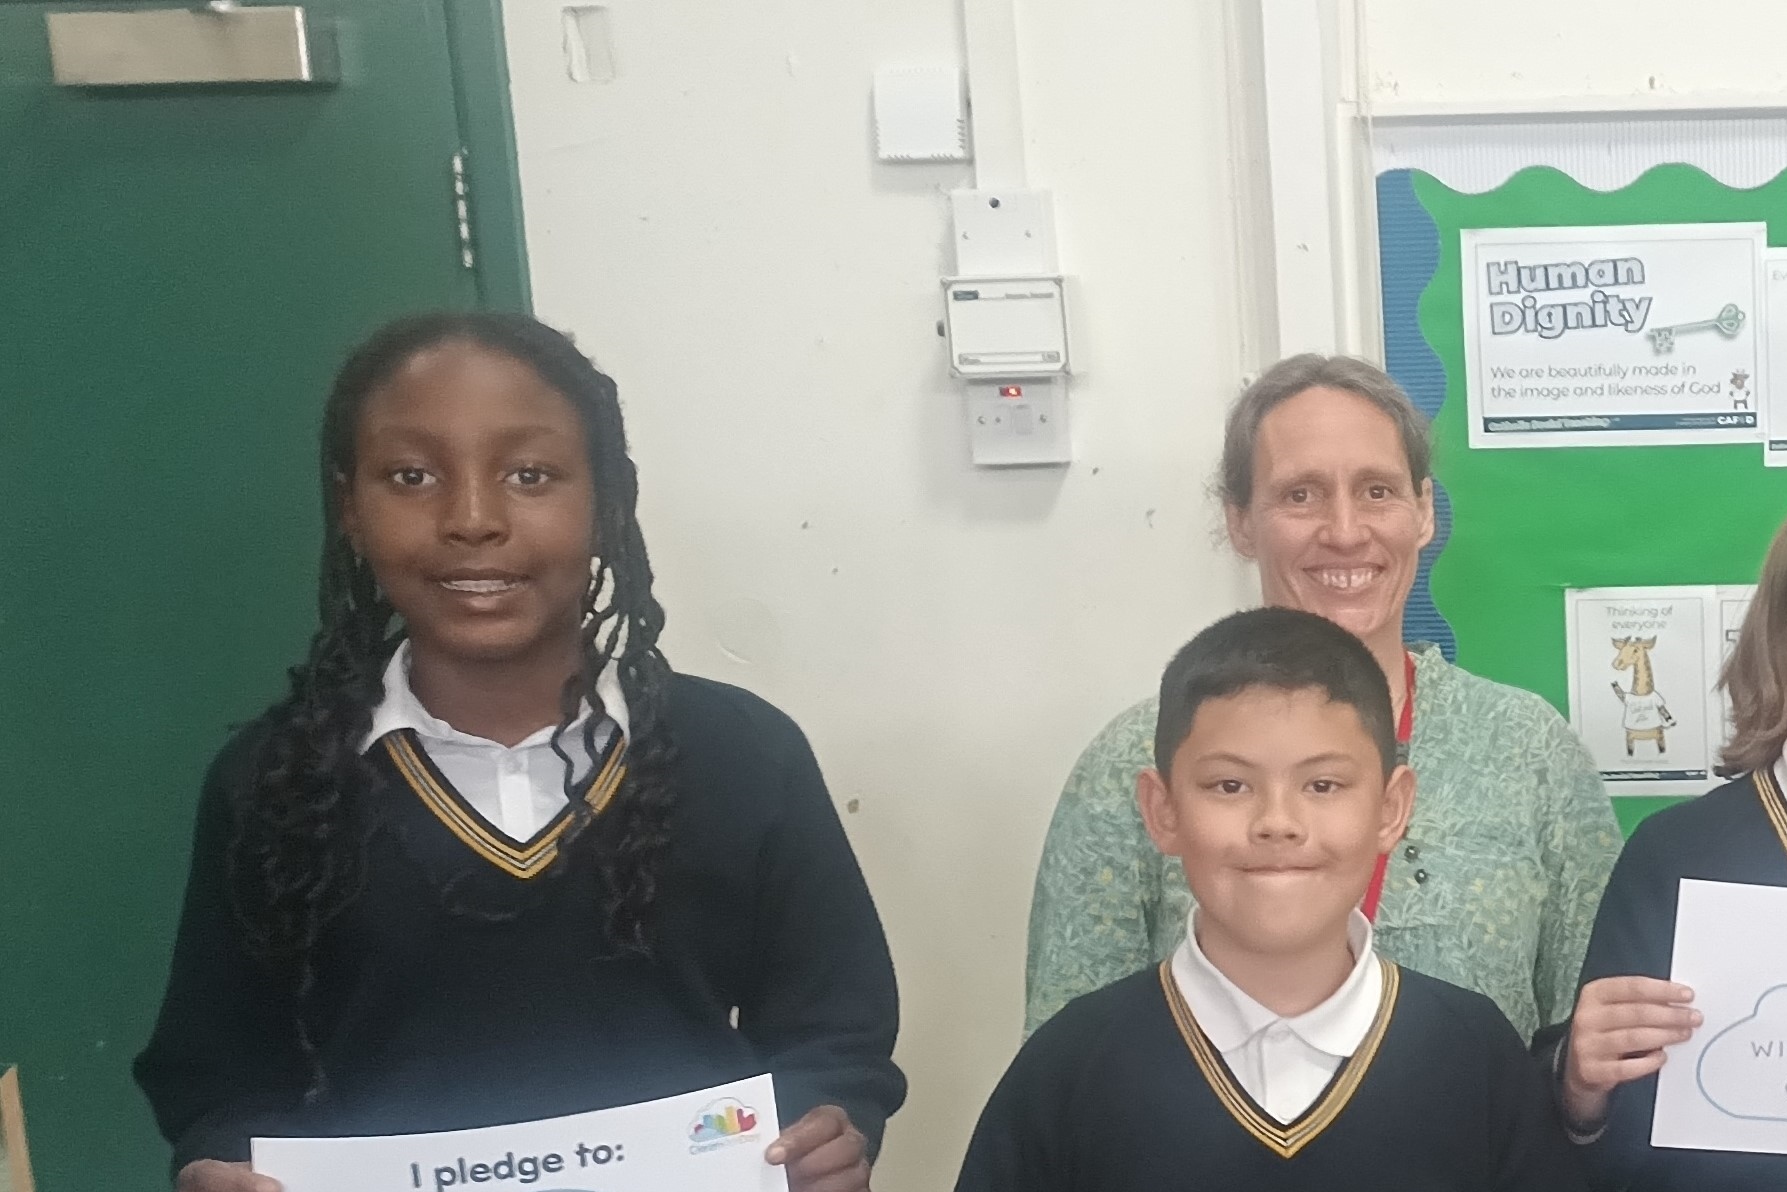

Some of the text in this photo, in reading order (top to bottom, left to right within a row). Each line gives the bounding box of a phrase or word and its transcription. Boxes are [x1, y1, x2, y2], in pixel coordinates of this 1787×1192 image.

[1487, 256, 1645, 295] Human
[1489, 290, 1653, 340] Dignity
[1490, 363, 1697, 380] We are beautifully made in
[1491, 381, 1721, 400] the image and likeness of God
[1605, 606, 1658, 617] Thinking
[1611, 621, 1667, 631] everyone
[411, 1141, 625, 1192] I pledge to:
